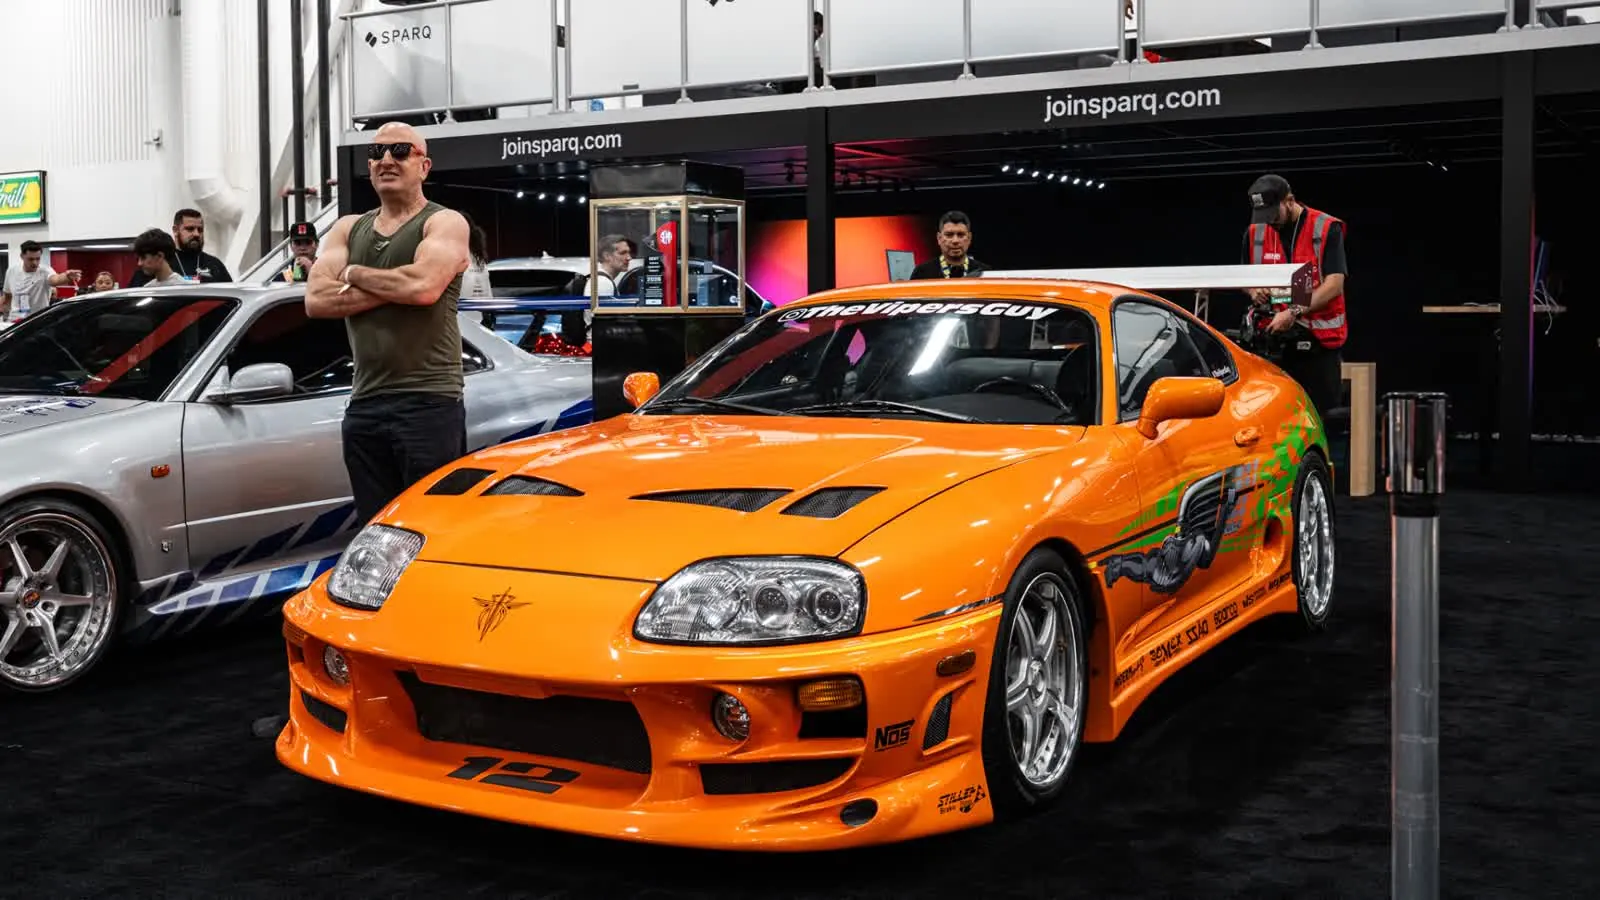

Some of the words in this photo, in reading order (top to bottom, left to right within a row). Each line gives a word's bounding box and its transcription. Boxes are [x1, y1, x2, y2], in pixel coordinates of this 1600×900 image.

[381, 25, 432, 44] SPARQ
[1043, 87, 1222, 123] joinsparq.com
[501, 133, 622, 160] joinsparq.com
[803, 301, 1059, 320] TheVipersGuy
[874, 718, 915, 752] NOS
[446, 755, 582, 795] 12
